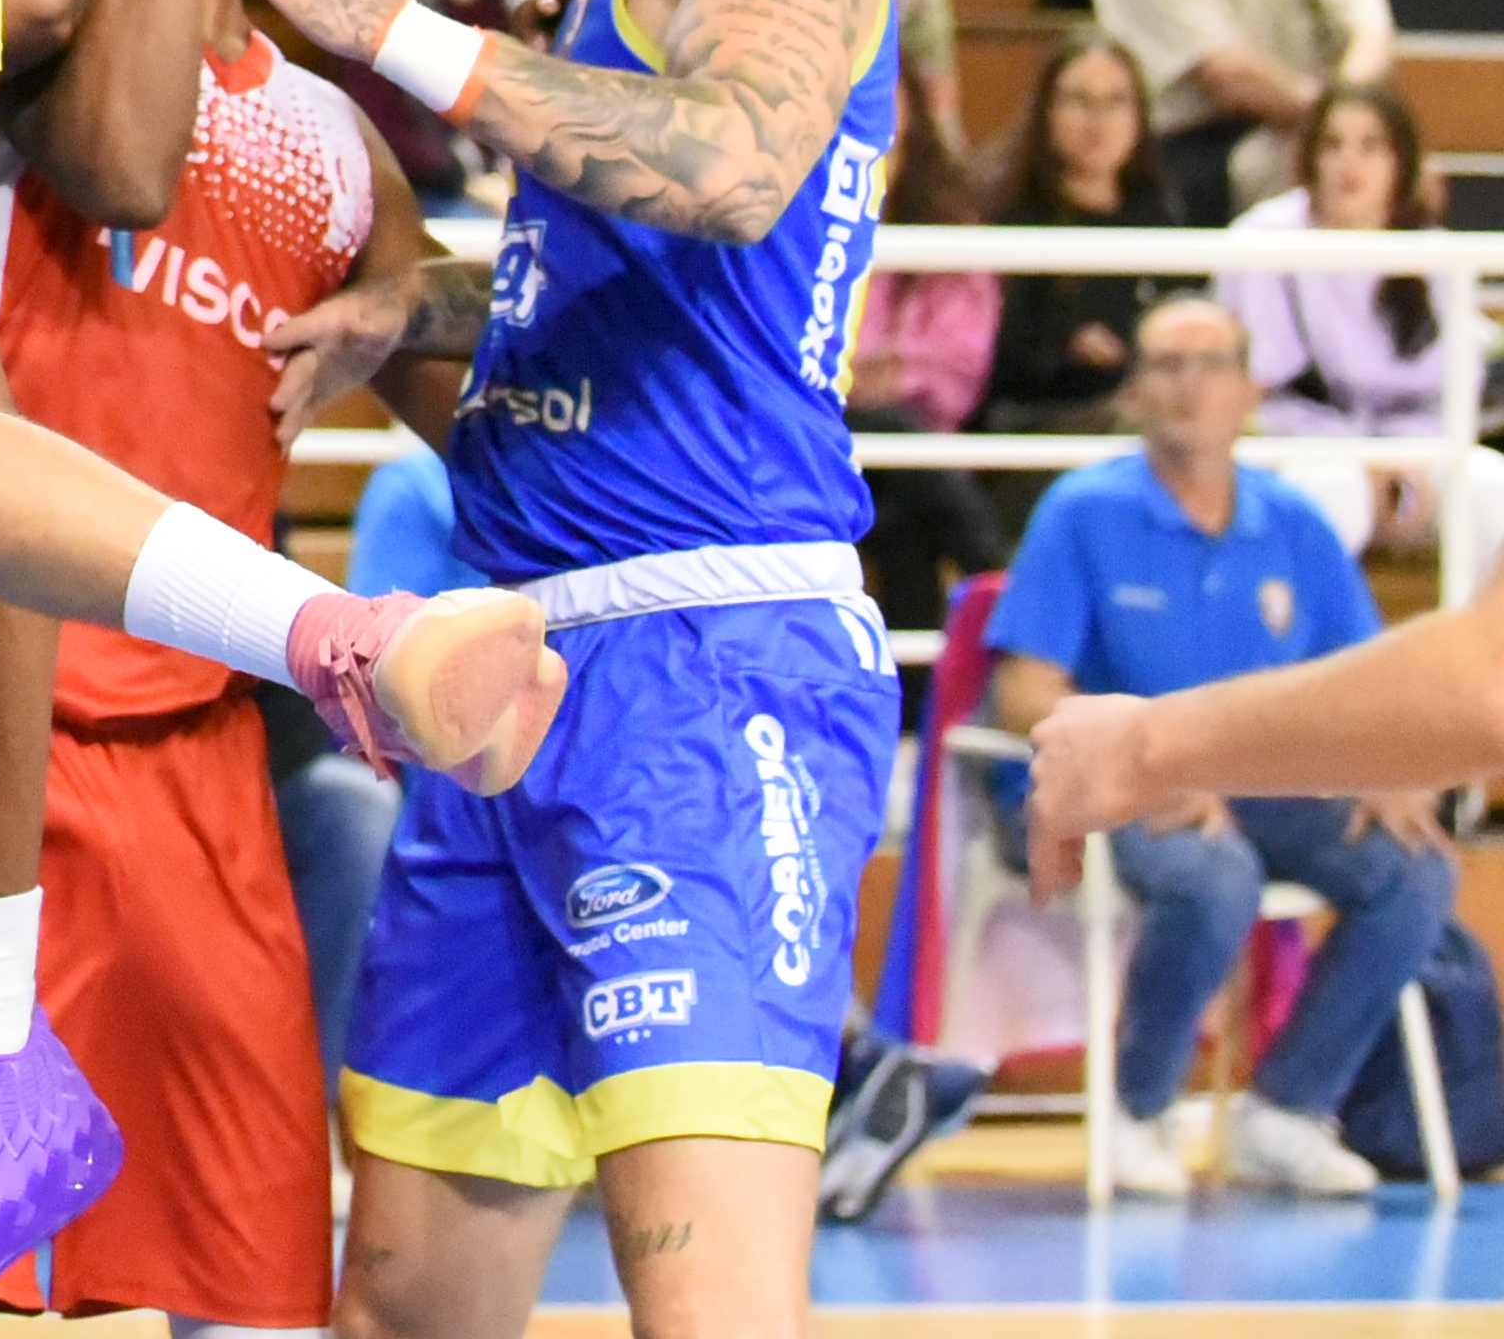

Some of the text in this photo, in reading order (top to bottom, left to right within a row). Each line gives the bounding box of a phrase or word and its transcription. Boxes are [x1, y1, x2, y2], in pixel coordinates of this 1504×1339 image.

[744, 713, 810, 987] CORNEJO
[578, 877, 642, 917] Ford
[613, 918, 690, 943] Center
[584, 971, 694, 1039] CBT
